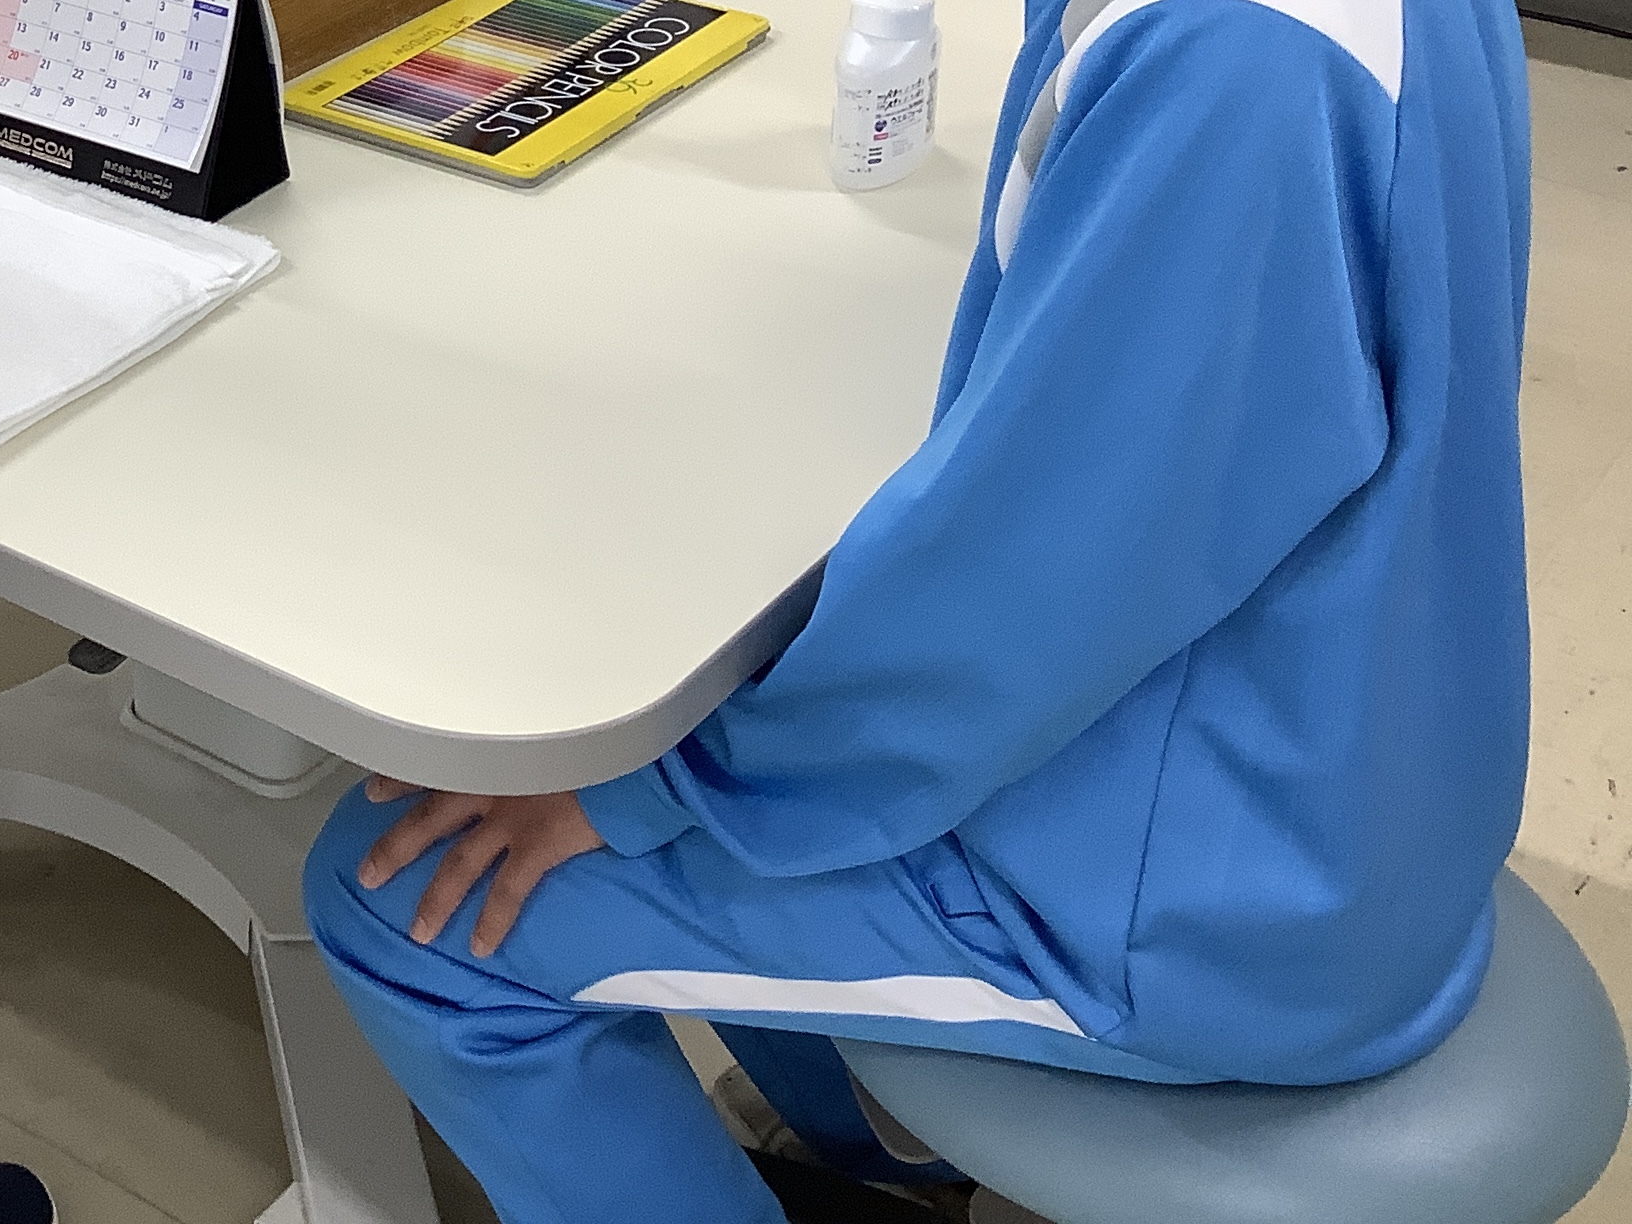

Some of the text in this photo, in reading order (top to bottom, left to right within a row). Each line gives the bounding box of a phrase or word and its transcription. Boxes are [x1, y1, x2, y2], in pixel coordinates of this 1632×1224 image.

[55, 2, 61, 13] 7
[86, 11, 93, 22] 8
[120, 20, 127, 31] 9
[154, 30, 166, 42] 10
[189, 40, 199, 52] 11
[159, 1, 166, 12] 3
[193, 11, 200, 22] 4
[17, 22, 27, 33] 13
[48, 31, 59, 42] 14
[81, 40, 92, 52] 15
[114, 49, 125, 62] 16
[148, 59, 159, 71] 17
[182, 69, 193, 81] 18
[475, 17, 690, 139] COLOR PENCILS
[8, 49, 20, 61] 20
[39, 58, 51, 70] 21
[72, 68, 85, 80] 22
[105, 78, 117, 90] 23
[138, 87, 151, 100] 24
[172, 97, 185, 109] 25
[30, 86, 42, 97] 28
[62, 96, 75, 107] 29
[95, 105, 108, 117] 30
[128, 116, 141, 128] 31
